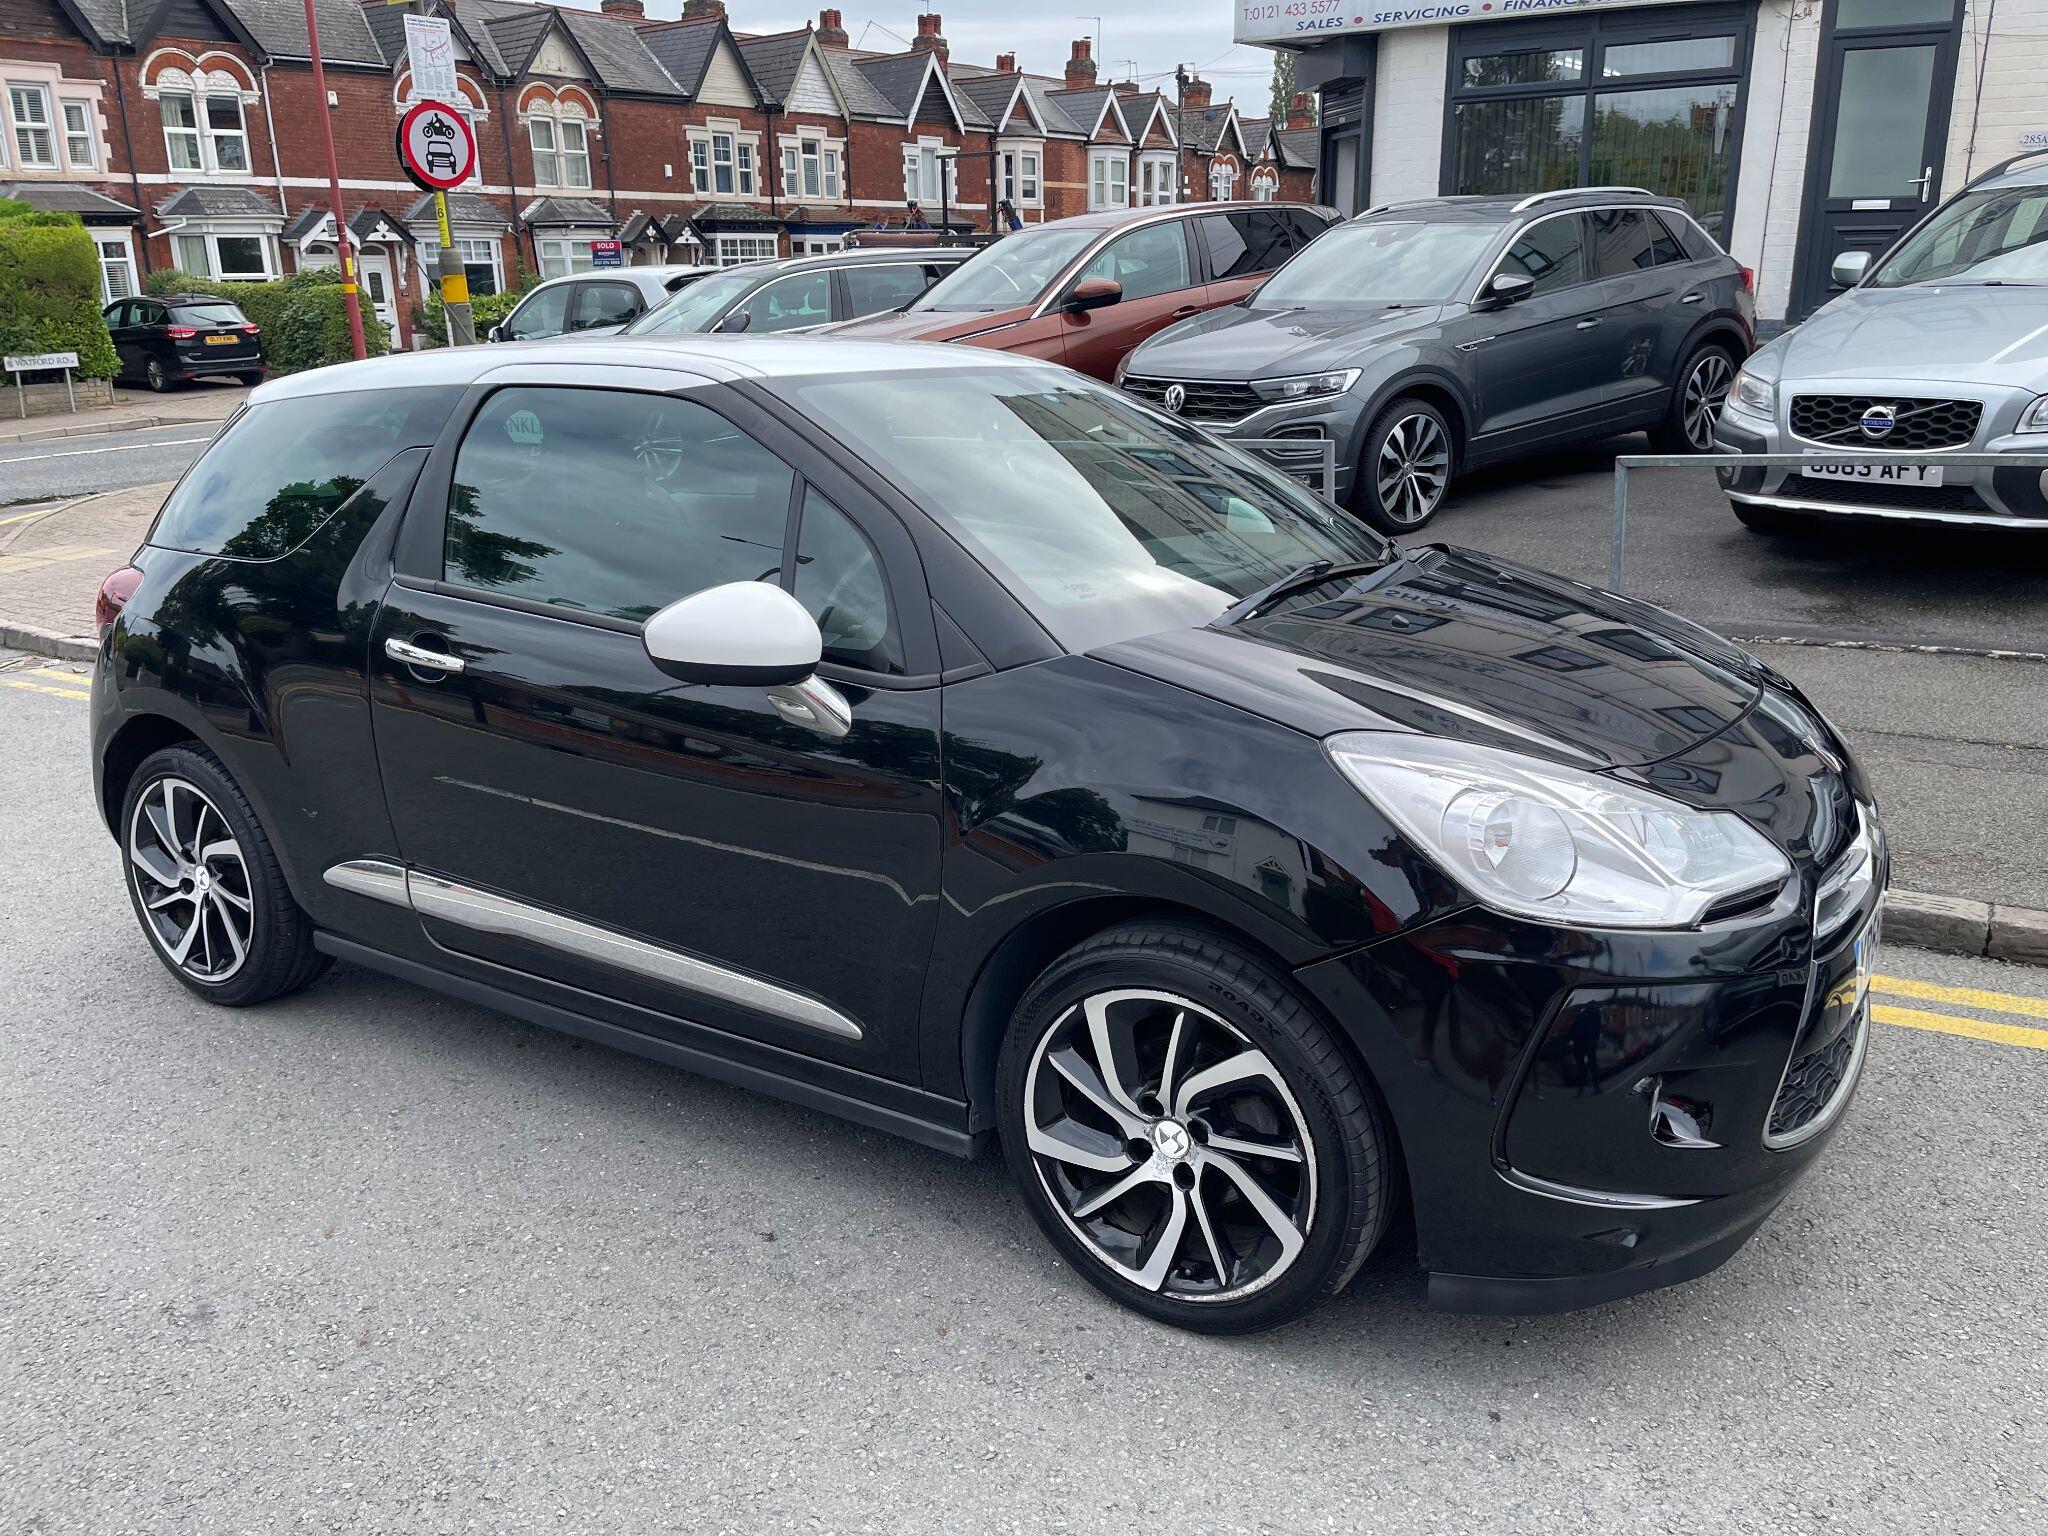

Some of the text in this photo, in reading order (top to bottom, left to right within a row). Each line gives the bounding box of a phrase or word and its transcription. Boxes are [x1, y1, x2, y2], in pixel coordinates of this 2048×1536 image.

[1243, 0, 1340, 20] T:0121 433 5577
[1296, 0, 1588, 31] SALES SERVICING FINAN
[2024, 134, 2048, 144] 285A
[15, 358, 55, 366] WATFORD
[1880, 464, 1929, 480] AFY
[1208, 981, 1282, 1039] ROADX
